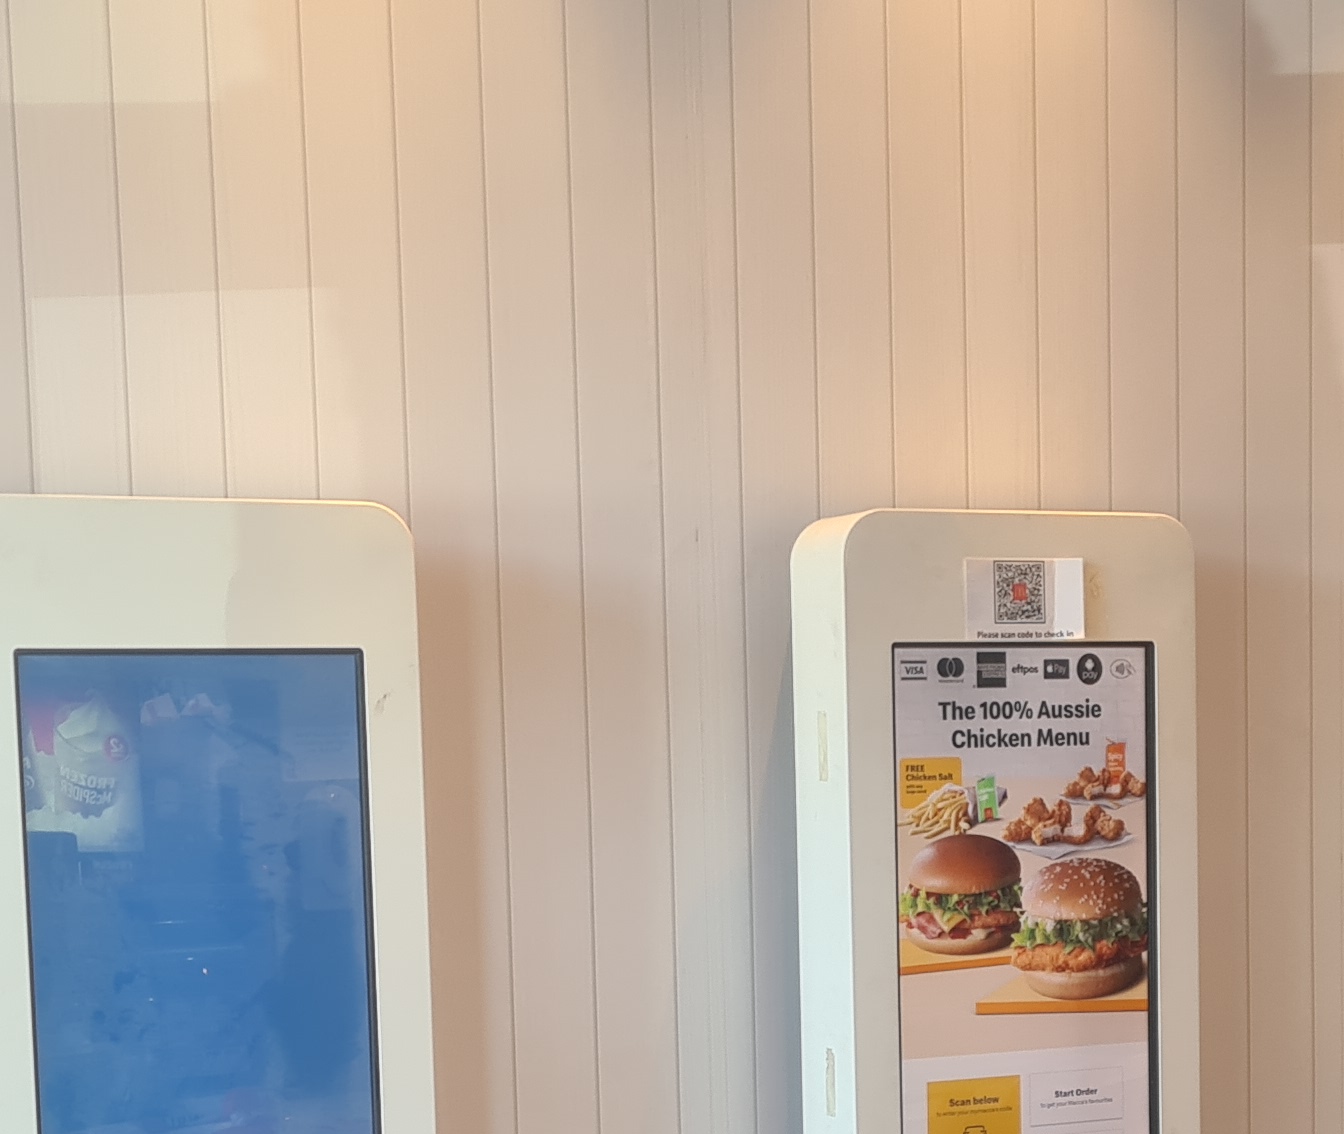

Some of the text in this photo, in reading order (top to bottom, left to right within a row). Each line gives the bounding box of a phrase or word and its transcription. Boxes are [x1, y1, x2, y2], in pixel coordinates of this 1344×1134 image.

[977, 631, 998, 639] Please
[1017, 631, 1033, 639] code
[1044, 630, 1064, 638] check
[904, 666, 924, 675] VISA
[1012, 664, 1038, 675] eftpos
[938, 698, 1102, 721] The 100% Aussie
[951, 728, 1090, 749] Chicken Menu
[906, 764, 925, 773] FREE
[906, 773, 954, 781] Chicken Salt
[1054, 1087, 1098, 1098] Start Order
[949, 1095, 1000, 1107] Scan below
